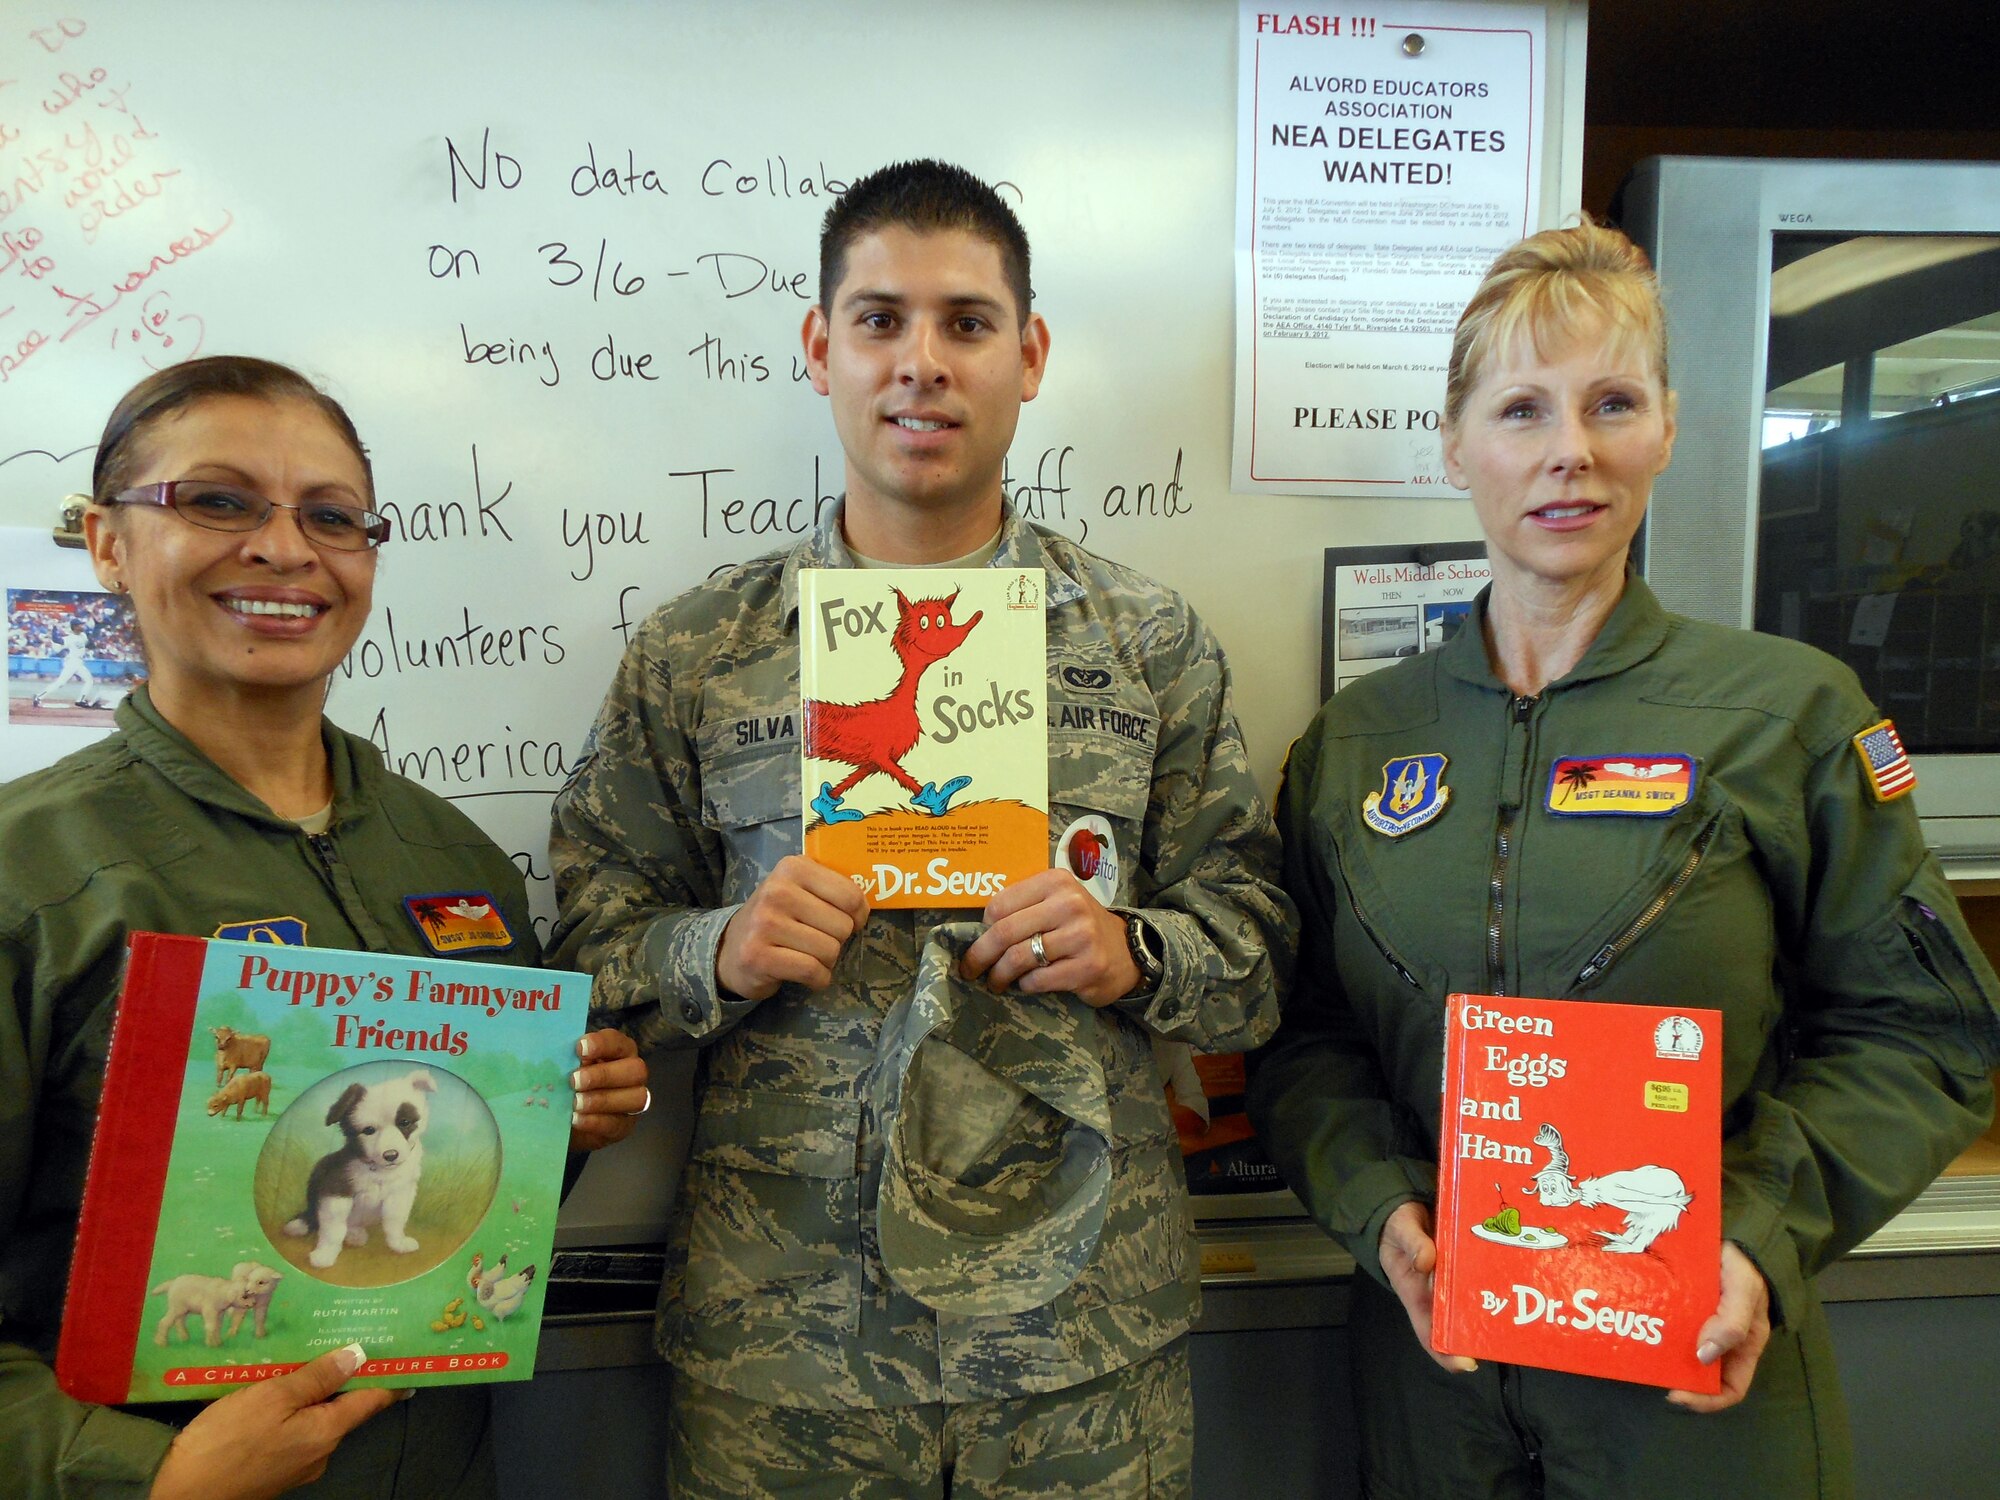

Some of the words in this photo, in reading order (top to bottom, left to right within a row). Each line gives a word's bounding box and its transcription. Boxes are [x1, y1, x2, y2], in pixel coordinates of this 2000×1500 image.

[1257, 14, 1340, 36] FLASH
[1352, 17, 1376, 37] !!!
[1289, 76, 1367, 95] ALVORD
[1373, 80, 1489, 97] EDUCATORS
[1324, 101, 1453, 119] ASSOCIATION
[1272, 124, 1328, 148] NEA
[1338, 127, 1506, 152] DELEGATES
[446, 126, 522, 203] No
[571, 142, 667, 197] data
[1323, 160, 1452, 185] WANTED!
[1778, 214, 1813, 223] WEGA
[429, 244, 480, 279] on
[538, 238, 646, 303] 3/6
[697, 253, 812, 300] Due
[1263, 313, 1301, 321] Declaration
[1314, 314, 1348, 324] Candidacy
[1371, 317, 1401, 325] complete
[1273, 329, 1303, 339] February
[461, 323, 560, 387] being
[592, 334, 660, 381] due
[1305, 361, 1332, 369] Election
[1293, 406, 1397, 430] PLEASE
[1405, 409, 1441, 431] PO
[1411, 475, 1431, 485] AEA
[380, 443, 513, 541] hank
[563, 508, 651, 581] you
[668, 454, 837, 538] Teach
[1001, 445, 1088, 545] taff,
[1103, 447, 1192, 518] and
[1353, 569, 1392, 585] Wells
[1394, 566, 1445, 583] Middle
[1447, 563, 1492, 580] Schoo
[1381, 591, 1402, 600] THEN
[1442, 588, 1464, 597] NOW
[820, 598, 888, 652] Fox
[943, 665, 963, 688] in
[932, 681, 1034, 744] Socks
[1060, 704, 1098, 731] AIR
[1099, 713, 1151, 742] FORCE
[736, 715, 795, 746] SILVA
[370, 706, 572, 782] America
[1575, 790, 1600, 801] MSGT
[1602, 789, 1641, 800] DEANNA
[1645, 790, 1676, 801] SWICK
[872, 864, 923, 900] Dr.
[927, 857, 1007, 897] Seuss
[1081, 849, 1119, 882] Visitor
[237, 954, 394, 1008] Puppy's
[403, 970, 562, 1018] Farmyard
[1461, 1004, 1555, 1037] Green
[330, 1014, 469, 1057] Friends
[1484, 1045, 1567, 1088] Eggs
[1461, 1096, 1522, 1122] and
[1459, 1133, 1533, 1165] Ham
[1227, 1160, 1276, 1177] Altura
[312, 1309, 347, 1318] RUTH
[351, 1307, 399, 1317] MARTIN
[1481, 1290, 1508, 1316] By
[1511, 1284, 1566, 1327] Dr.
[1571, 1288, 1665, 1345] Seuss
[306, 1337, 341, 1346] JOHN
[346, 1335, 394, 1345] BUTLER
[174, 1371, 187, 1382] A
[204, 1367, 297, 1382] CHANG
[355, 1358, 434, 1374] ICTURE
